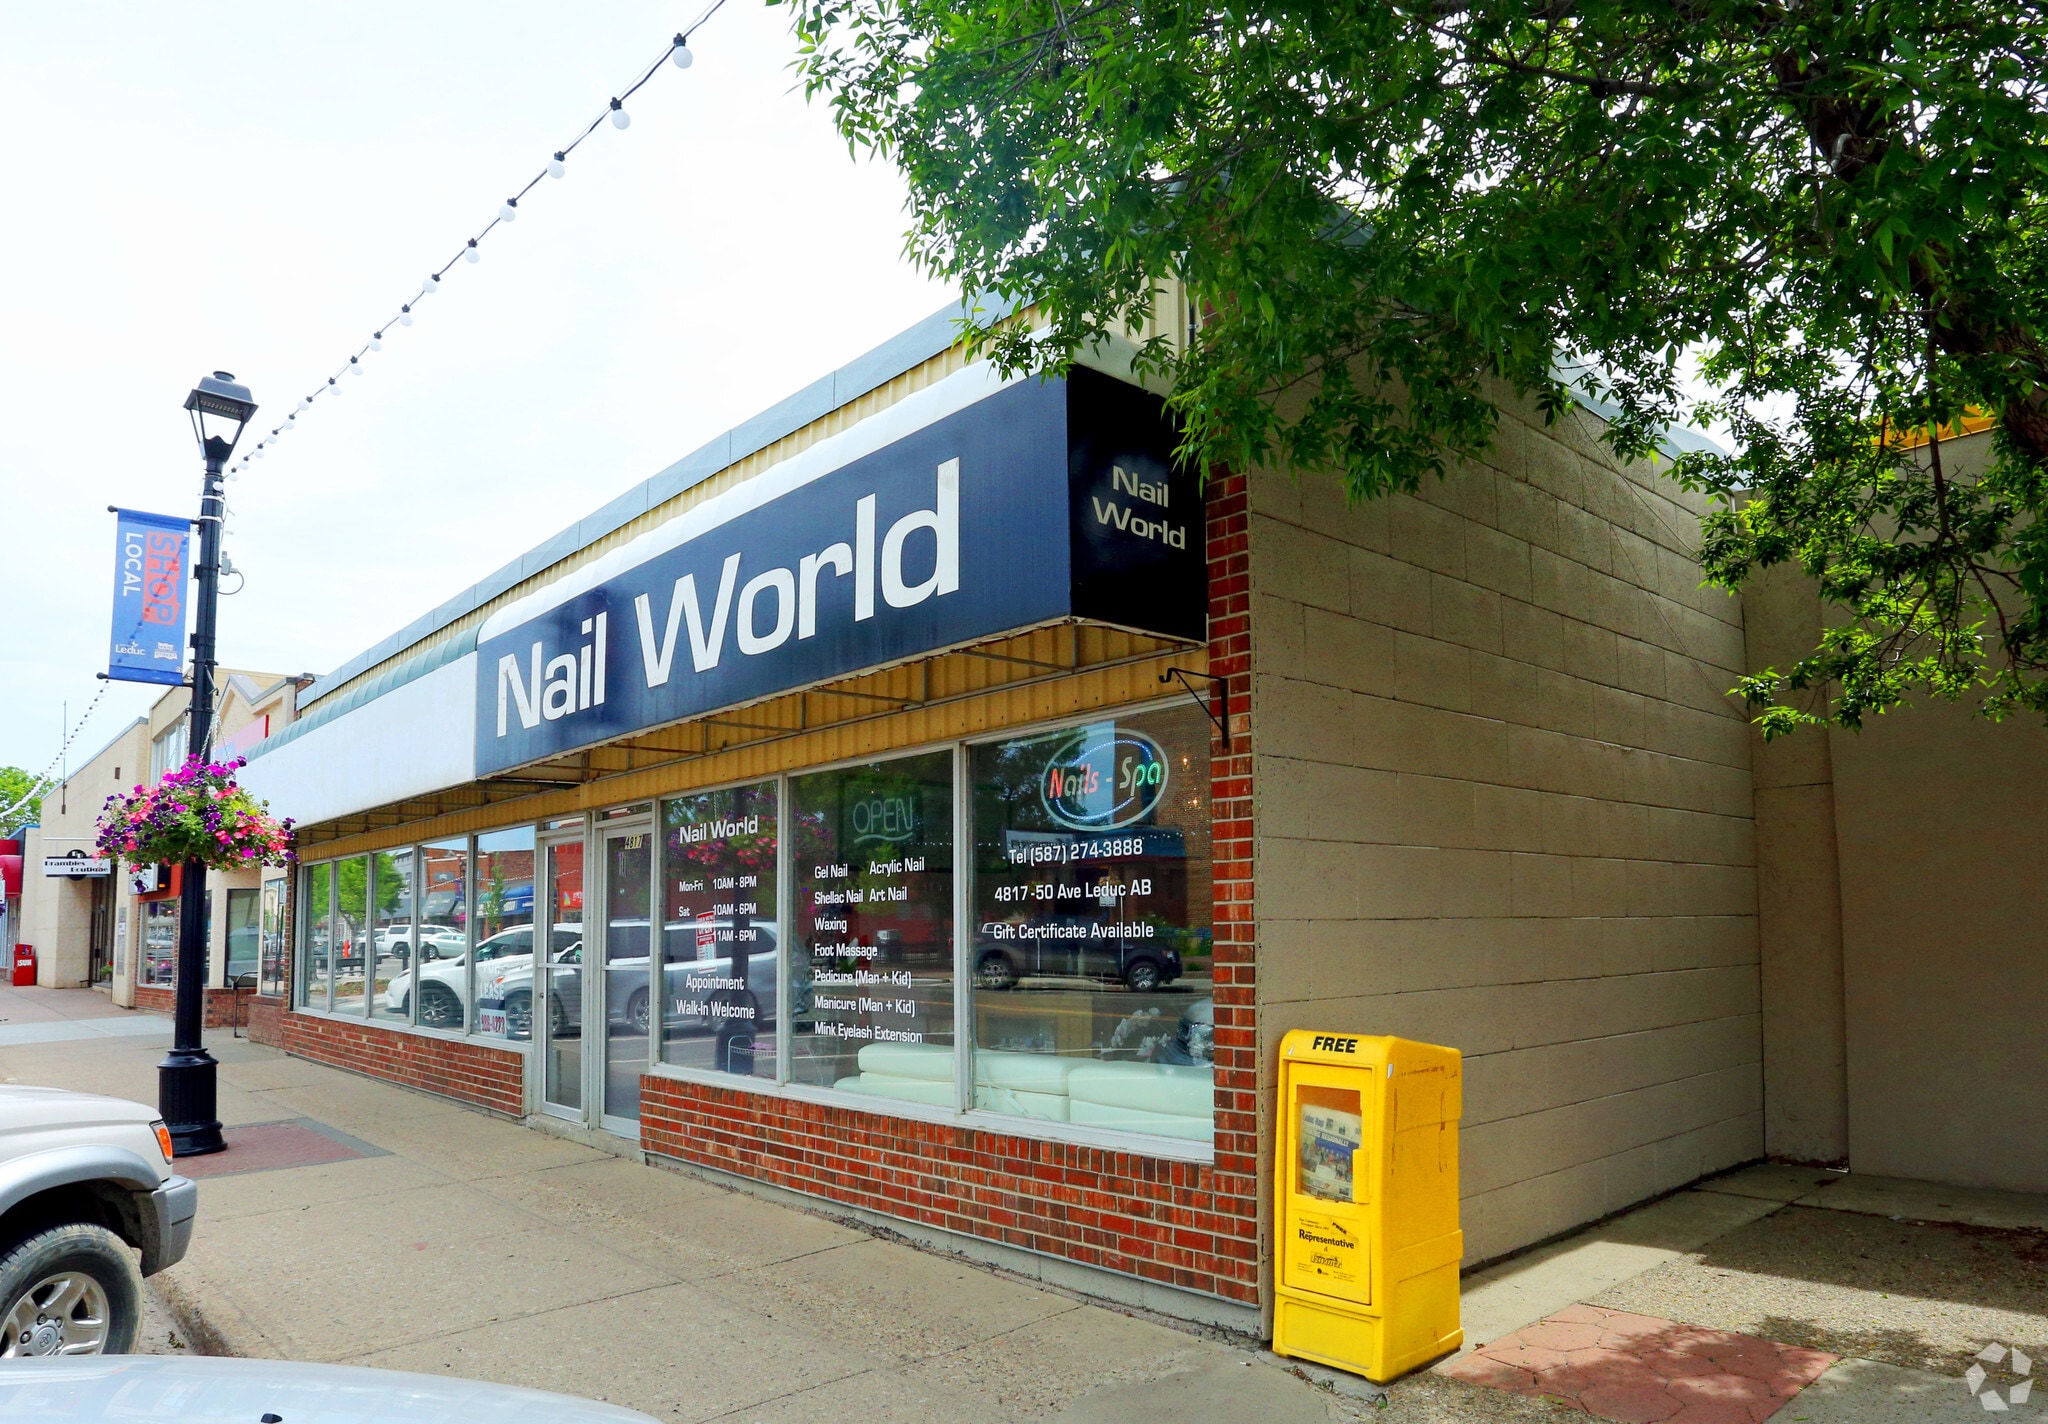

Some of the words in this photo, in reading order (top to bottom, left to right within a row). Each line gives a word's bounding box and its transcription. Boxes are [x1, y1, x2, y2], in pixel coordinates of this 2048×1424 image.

[1112, 465, 1169, 508] Nail
[1092, 496, 1186, 550] World
[123, 532, 144, 597] LOCAL
[147, 534, 177, 622] SHOP
[497, 611, 608, 738] Nail
[634, 456, 960, 689] World
[115, 643, 146, 656] Leduc
[1049, 763, 1099, 799] Nails
[1119, 756, 1162, 797] Spa
[853, 796, 913, 834] OPEN
[679, 822, 707, 844] Nail
[710, 815, 759, 839] World
[625, 835, 643, 849] 4817
[1009, 849, 1027, 865] Tel
[1030, 845, 1067, 866] (587)
[1070, 838, 1143, 860] 274-3888
[814, 865, 829, 879] Gel
[830, 864, 849, 878] Nail
[869, 859, 902, 877] Acrylic
[904, 856, 925, 872] Nail
[679, 880, 704, 892] Mon-Fri
[713, 877, 734, 890] 10AM
[739, 875, 757, 888] 8PM
[994, 884, 1029, 902] 4817
[1057, 883, 1082, 899] Ave
[1085, 881, 1126, 898] Leduc
[1130, 879, 1152, 896] AB
[814, 890, 845, 905] Shellac
[846, 889, 864, 903] Nail
[869, 888, 886, 902] Art
[888, 886, 908, 901] Nail
[678, 906, 691, 917] Sat
[713, 903, 734, 915] 10AM
[739, 903, 757, 915] 6PM
[739, 929, 757, 941] 6PM
[814, 917, 848, 934] Waxing
[993, 923, 1016, 940] Gift
[1018, 923, 1087, 940] Certificate
[1090, 921, 1154, 938] Available
[814, 943, 835, 957] Foot
[836, 943, 878, 960] Massage
[686, 974, 745, 992] Appointment
[814, 969, 853, 983] Pedicure
[855, 970, 880, 987] (Man
[891, 971, 912, 989] Kid)
[480, 982, 505, 1001] LEASE
[676, 999, 709, 1016] Walk-In
[711, 1001, 755, 1019] Welcome
[814, 995, 857, 1010] Manicure
[858, 997, 883, 1014] (Man
[895, 999, 916, 1017] Kid)
[814, 1021, 836, 1036] Mink
[838, 1023, 873, 1040] Eyelash
[874, 1025, 923, 1044] Extension
[1312, 1036, 1359, 1054] FREE
[1298, 1228, 1355, 1250] Representative
